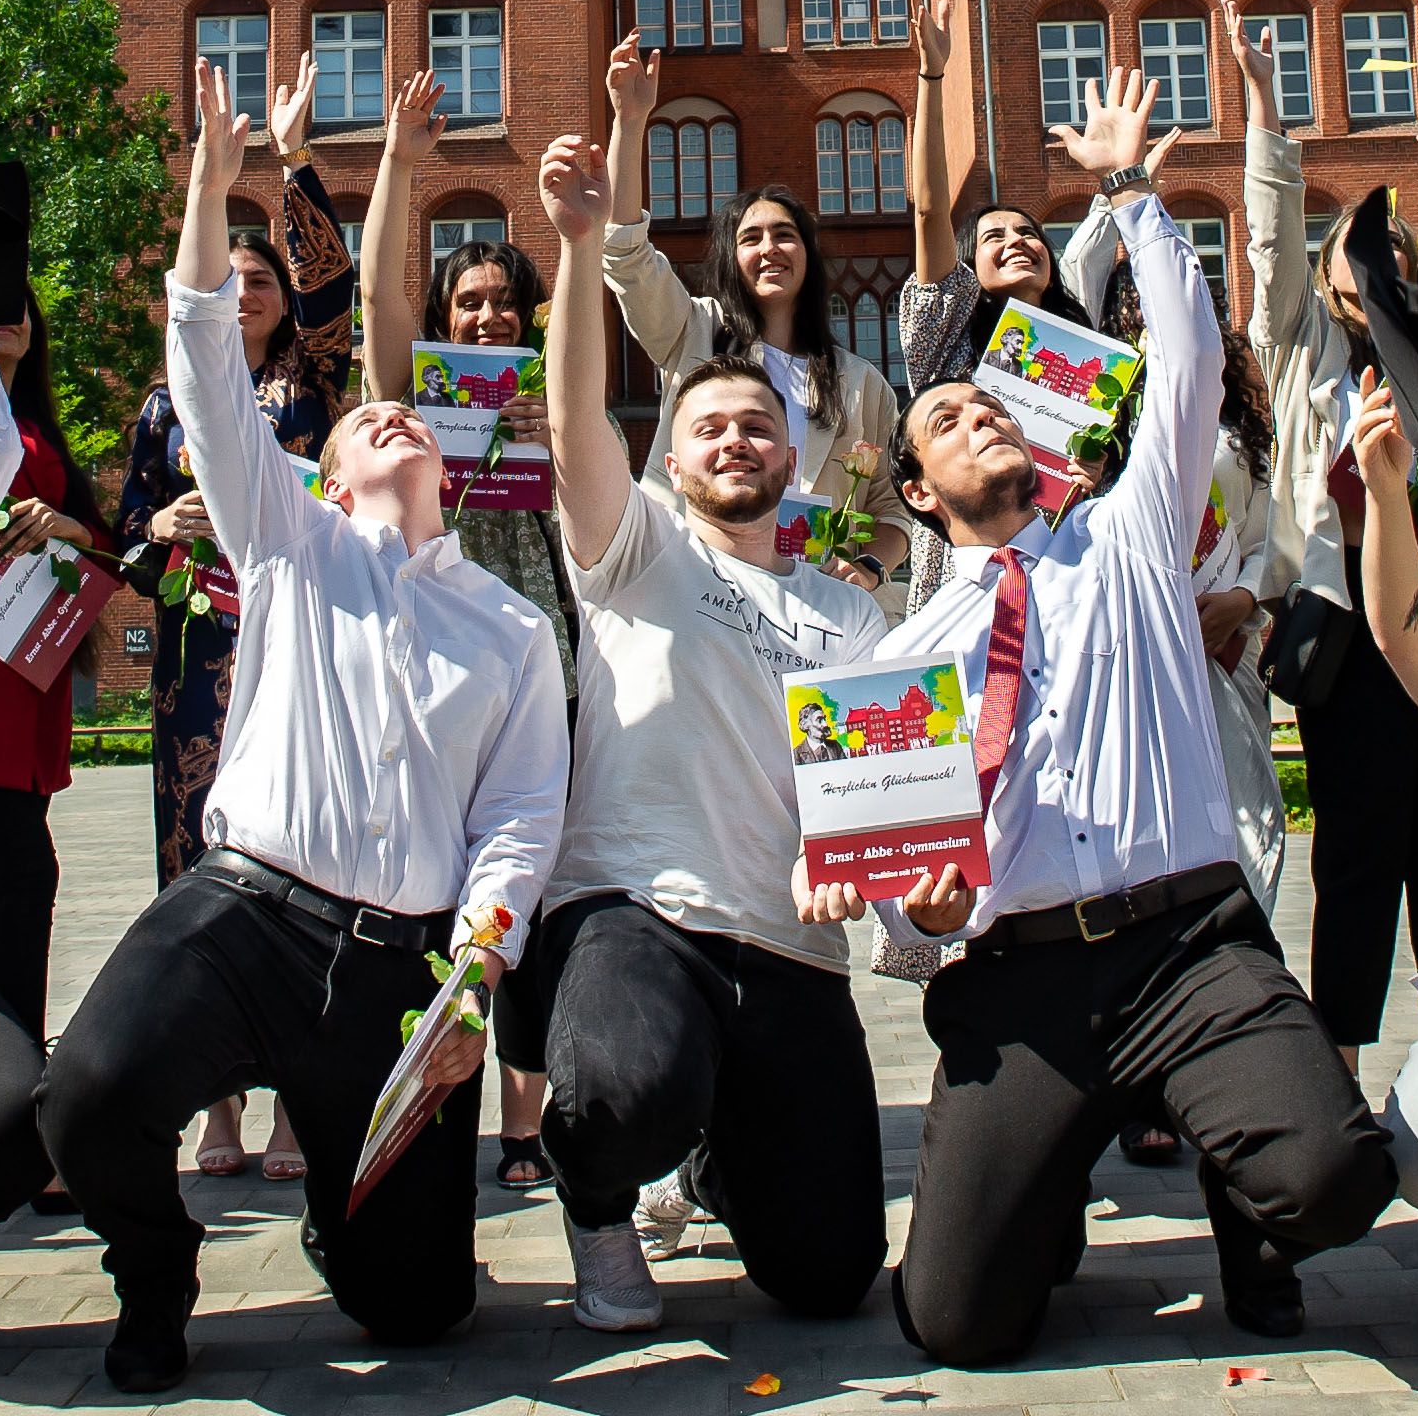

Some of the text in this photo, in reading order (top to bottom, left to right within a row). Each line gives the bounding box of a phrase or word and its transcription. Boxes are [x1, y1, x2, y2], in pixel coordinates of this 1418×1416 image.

[434, 421, 476, 433] Herzlichen
[462, 471, 484, 479] Abe
[126, 630, 146, 643] N2
[821, 766, 956, 797] Herzlichen Glückwunsch!
[825, 851, 854, 865] Ernst
[863, 846, 893, 860] Abbe
[902, 837, 971, 856] Gymnasium
[867, 871, 898, 881] Tradition
